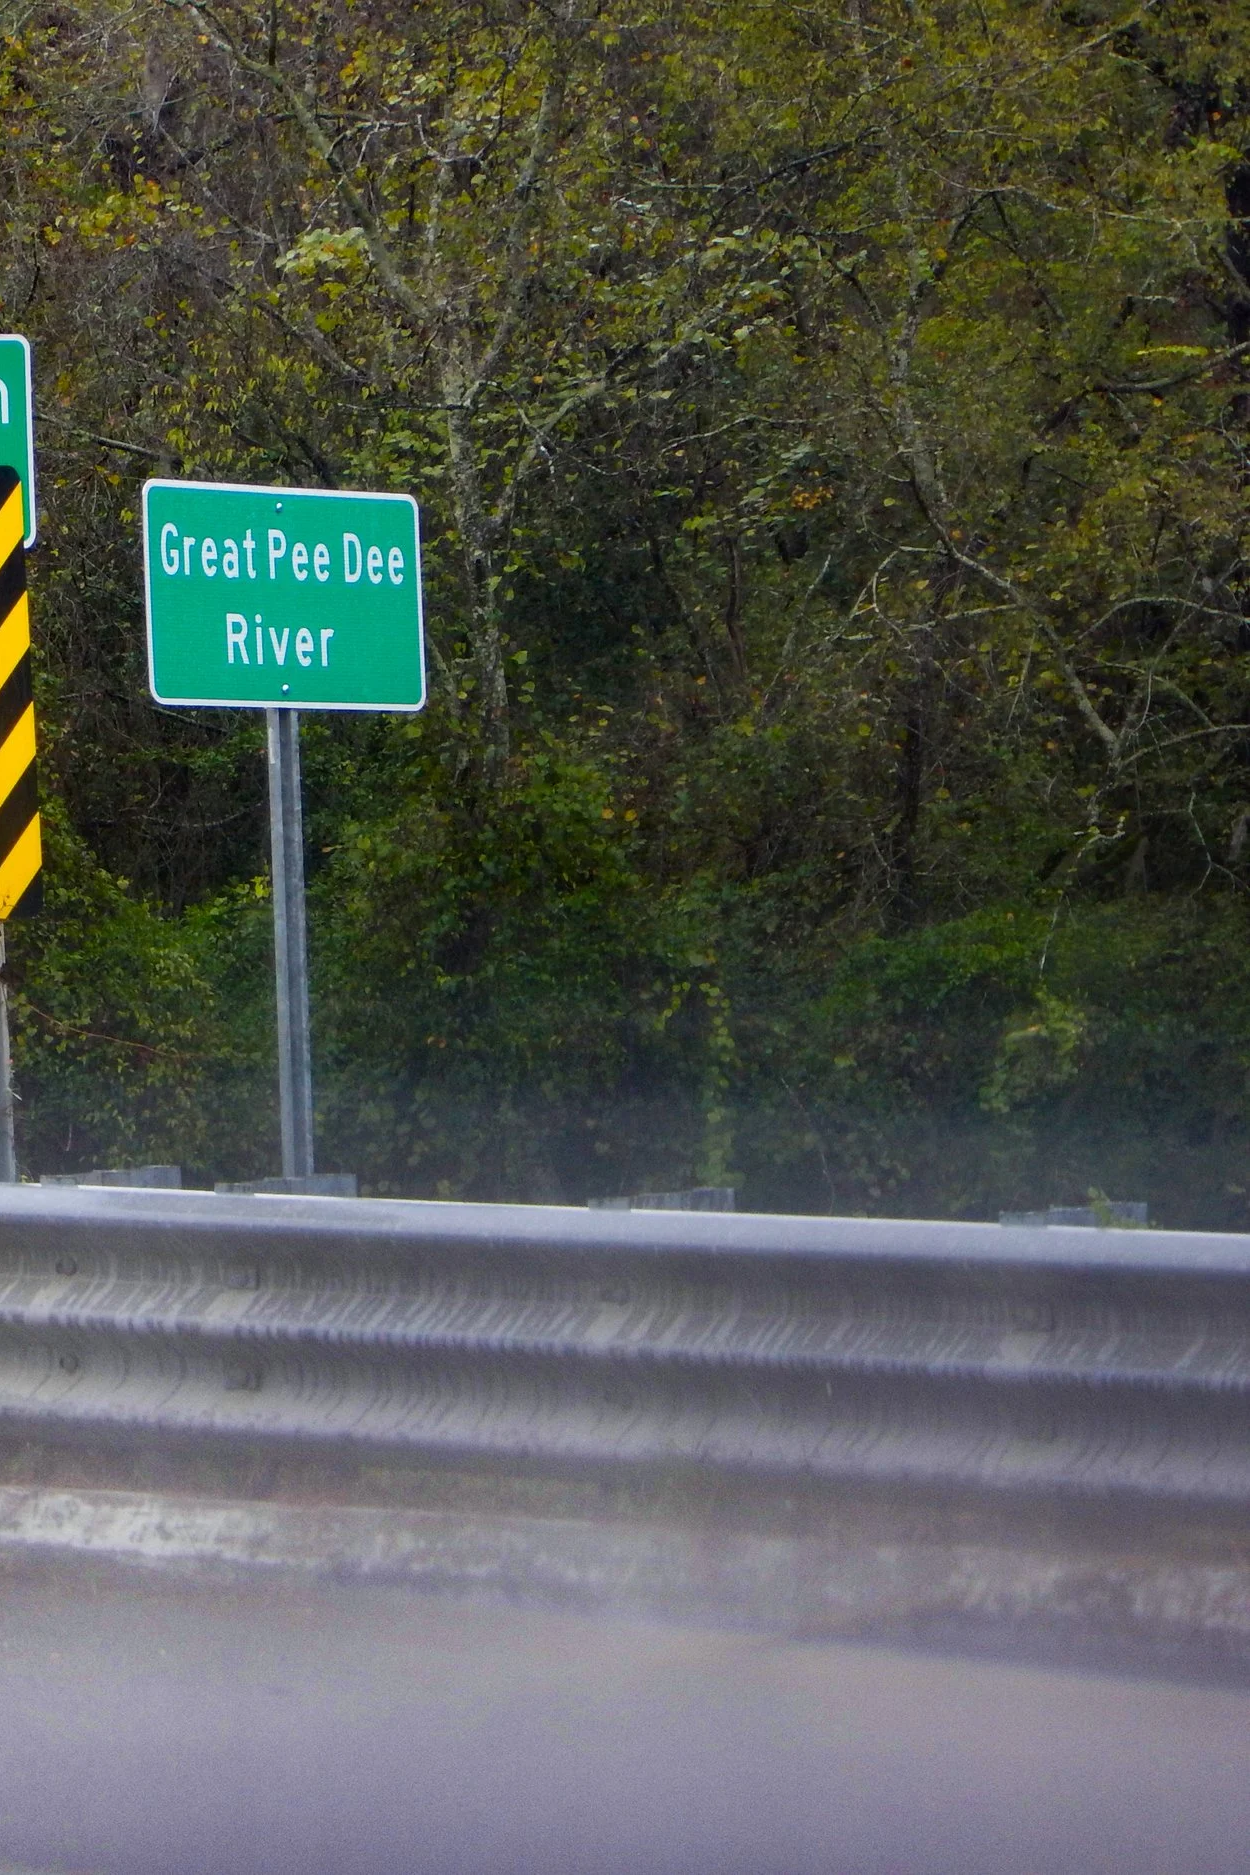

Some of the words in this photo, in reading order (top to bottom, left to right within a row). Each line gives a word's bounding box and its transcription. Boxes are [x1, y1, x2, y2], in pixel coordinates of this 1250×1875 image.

[160, 522, 257, 579] Great
[267, 528, 330, 582] Pee
[343, 532, 405, 585] Dee
[226, 612, 335, 667] River
